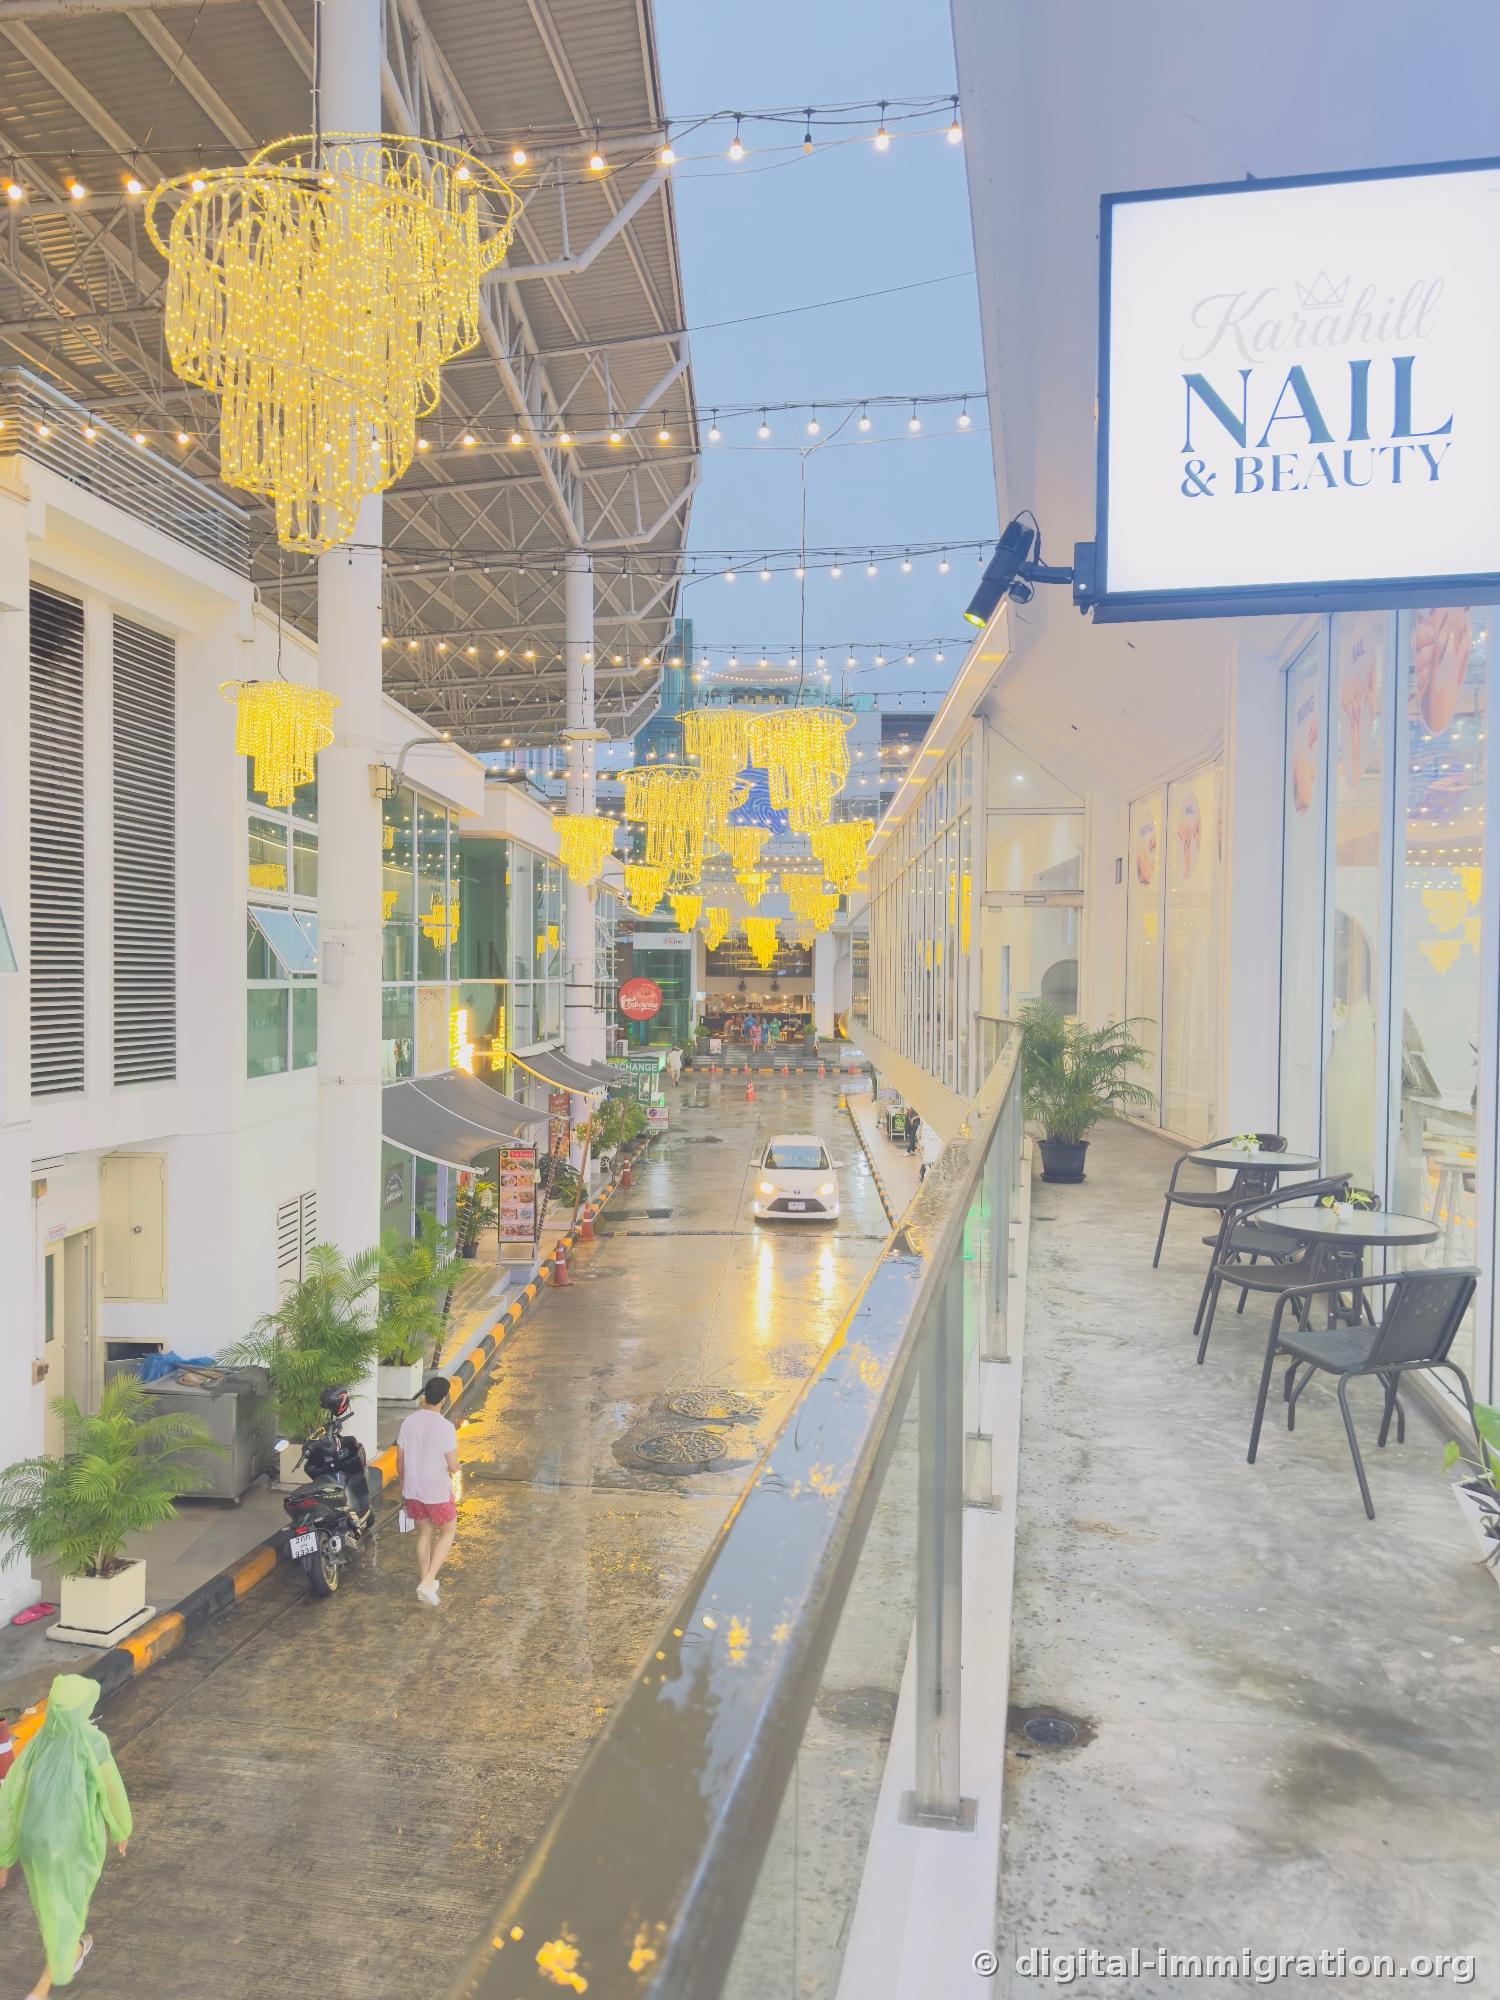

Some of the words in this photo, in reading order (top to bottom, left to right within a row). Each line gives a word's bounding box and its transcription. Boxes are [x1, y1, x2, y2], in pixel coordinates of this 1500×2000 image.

[1179, 277, 1444, 364] Karahill
[1181, 355, 1454, 453] NAIL
[1181, 459, 1217, 497] &
[1234, 442, 1452, 494] BEAUTY
[607, 1063, 657, 1072] EXCHANGE
